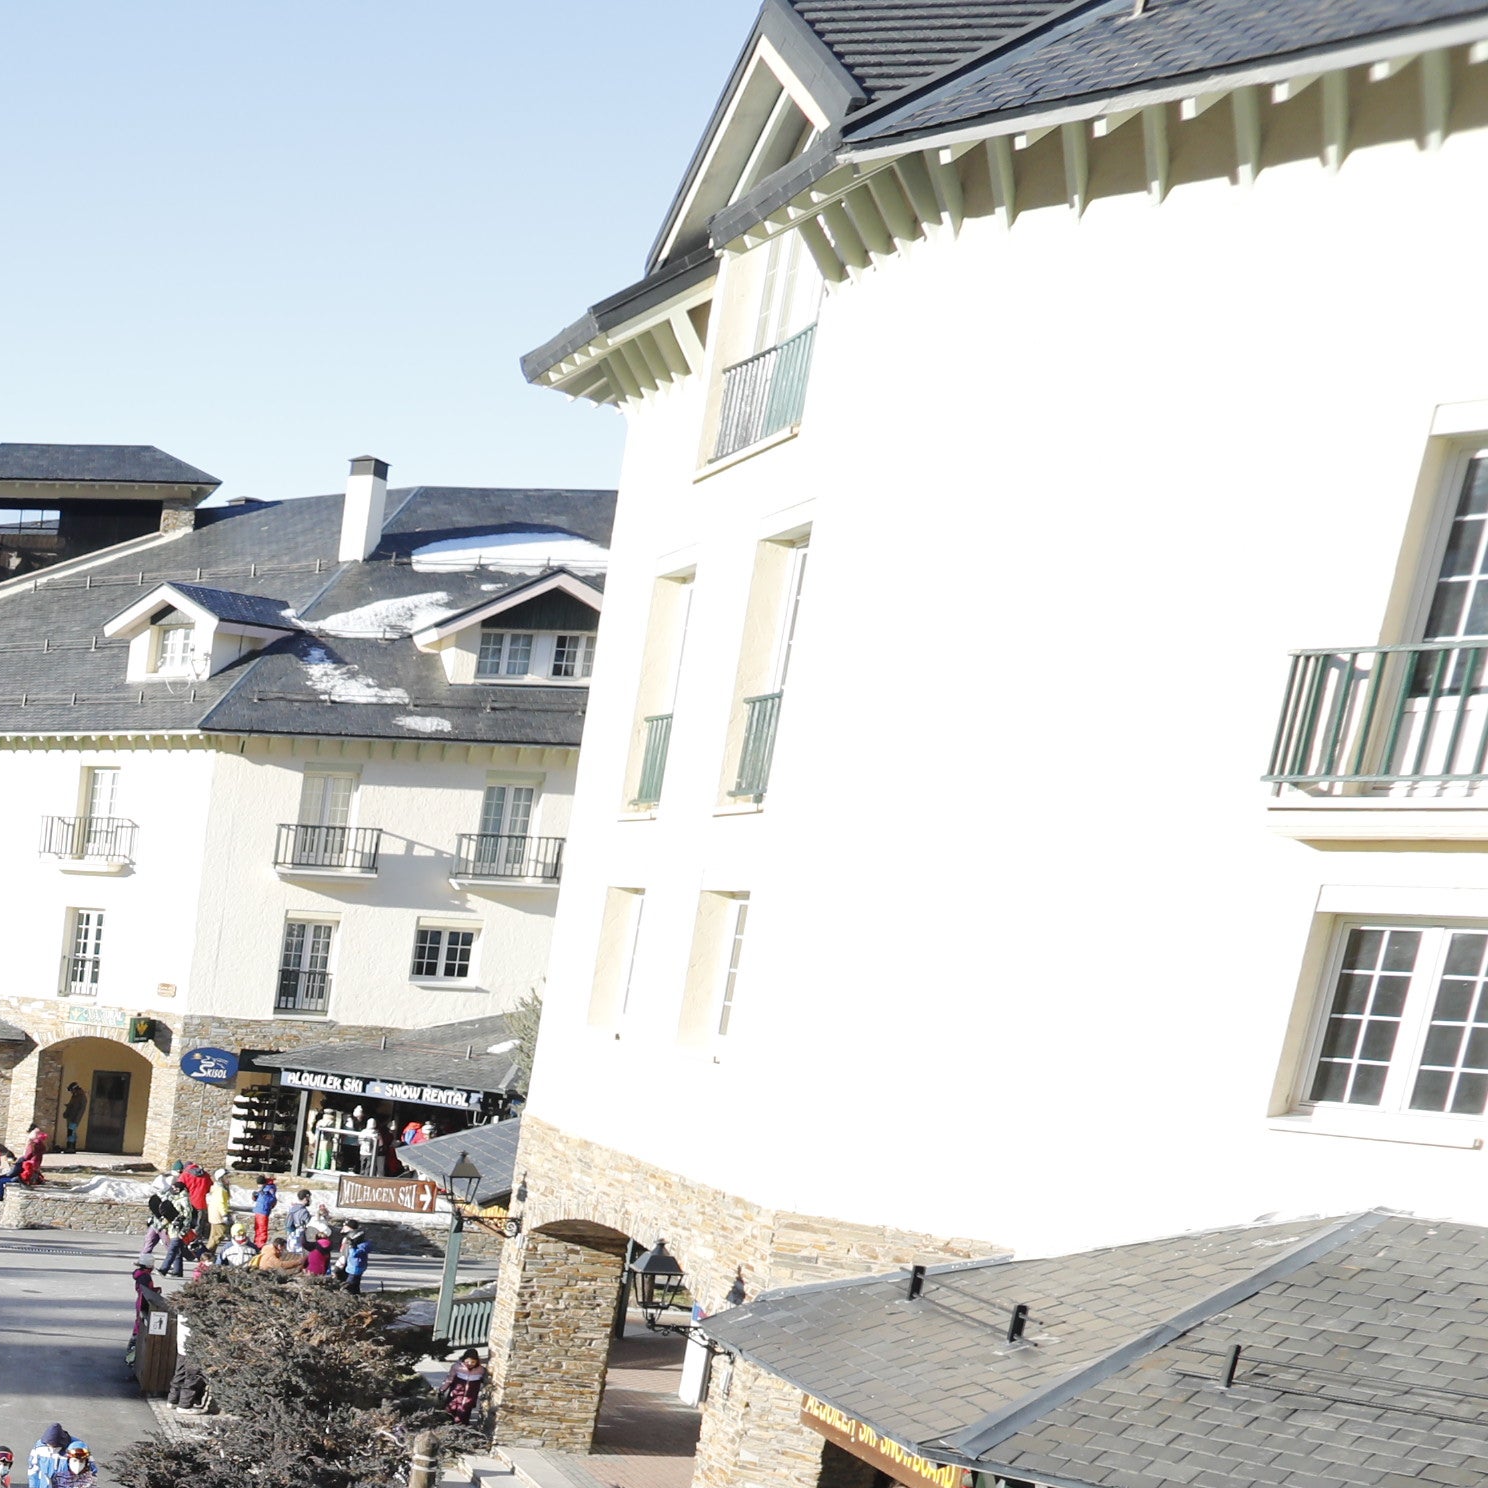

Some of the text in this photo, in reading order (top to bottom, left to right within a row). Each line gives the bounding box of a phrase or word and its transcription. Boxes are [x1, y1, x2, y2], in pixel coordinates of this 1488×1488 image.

[287, 1071, 470, 1106] ALQUILER SKI SNOW RENTAL
[339, 1180, 418, 1210] MULHACEN SKI
